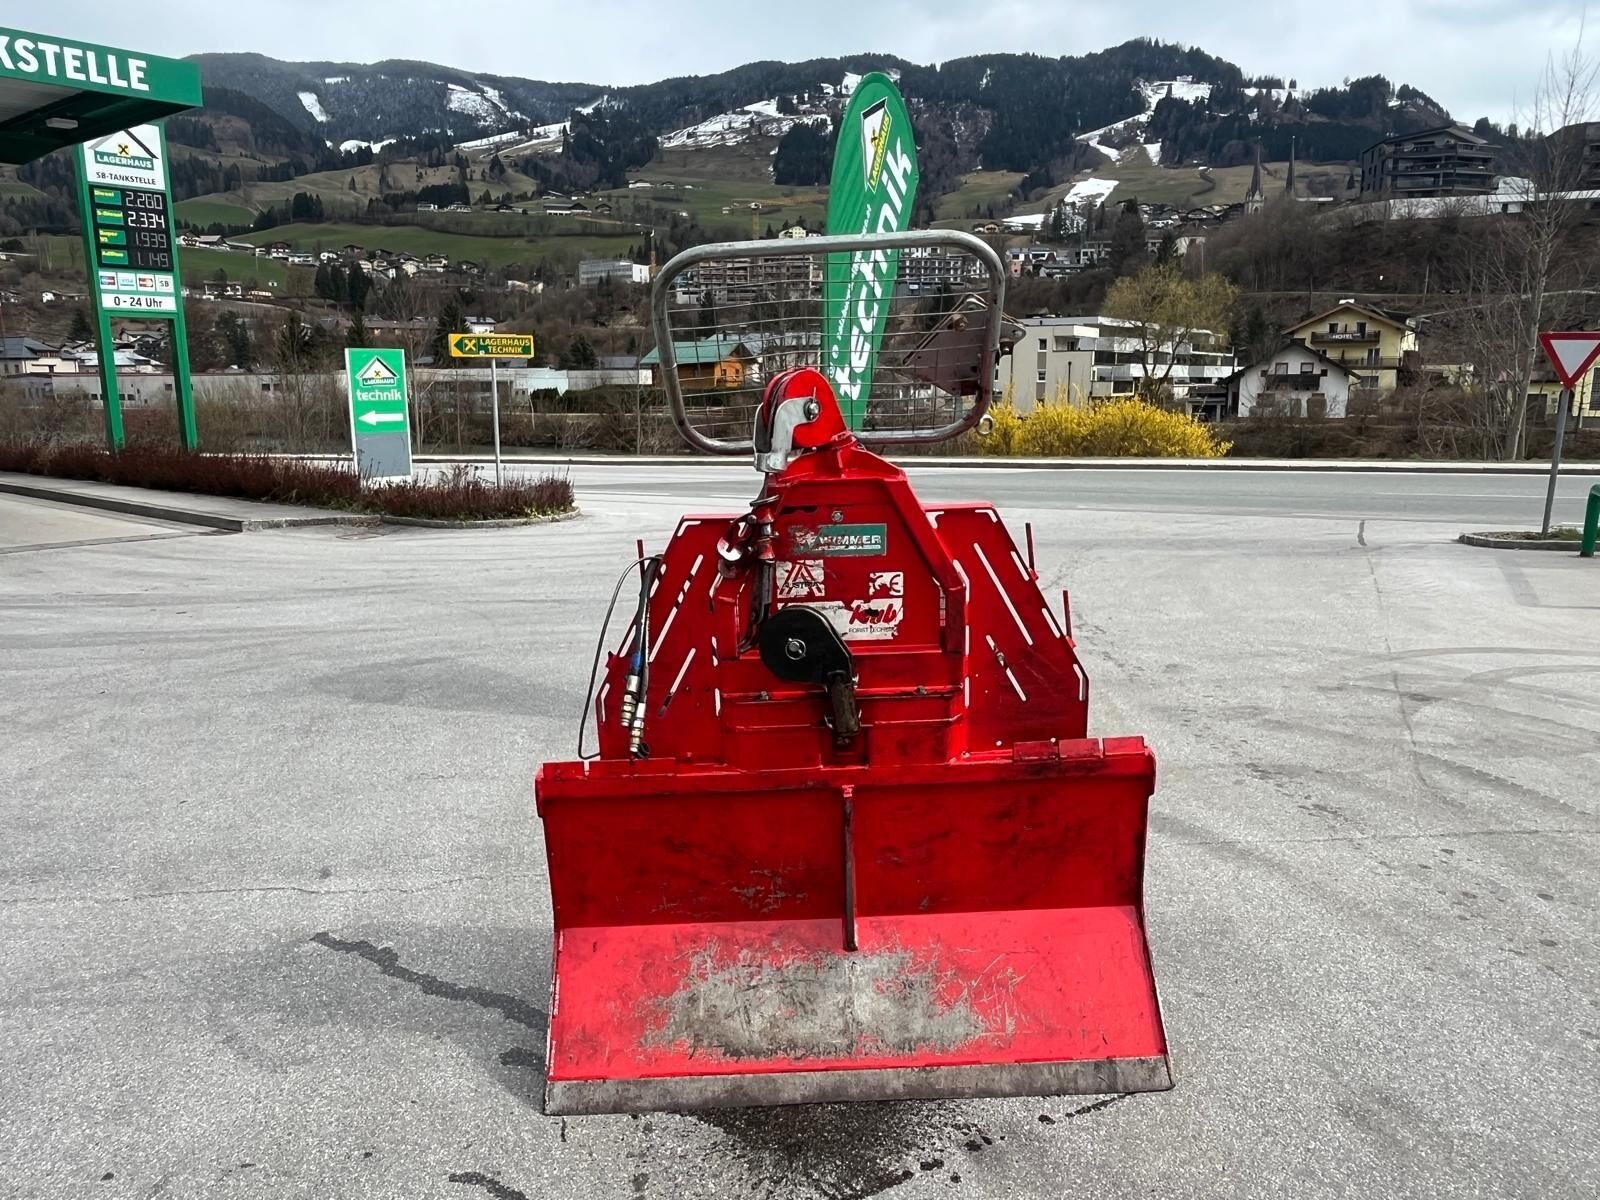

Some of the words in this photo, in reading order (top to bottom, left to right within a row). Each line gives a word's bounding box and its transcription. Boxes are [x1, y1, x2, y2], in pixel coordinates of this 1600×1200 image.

[869, 115, 890, 187] LAGERHAUS
[96, 154, 152, 168] LAGERHAUS
[96, 171, 156, 185] SB-TANKSTELLE
[128, 211, 165, 229] 2.334
[135, 231, 167, 248] 1.939
[129, 296, 142, 307] 24
[145, 297, 162, 308] Uhr
[480, 338, 530, 346] LAGERHAUS
[356, 389, 402, 400] technik
